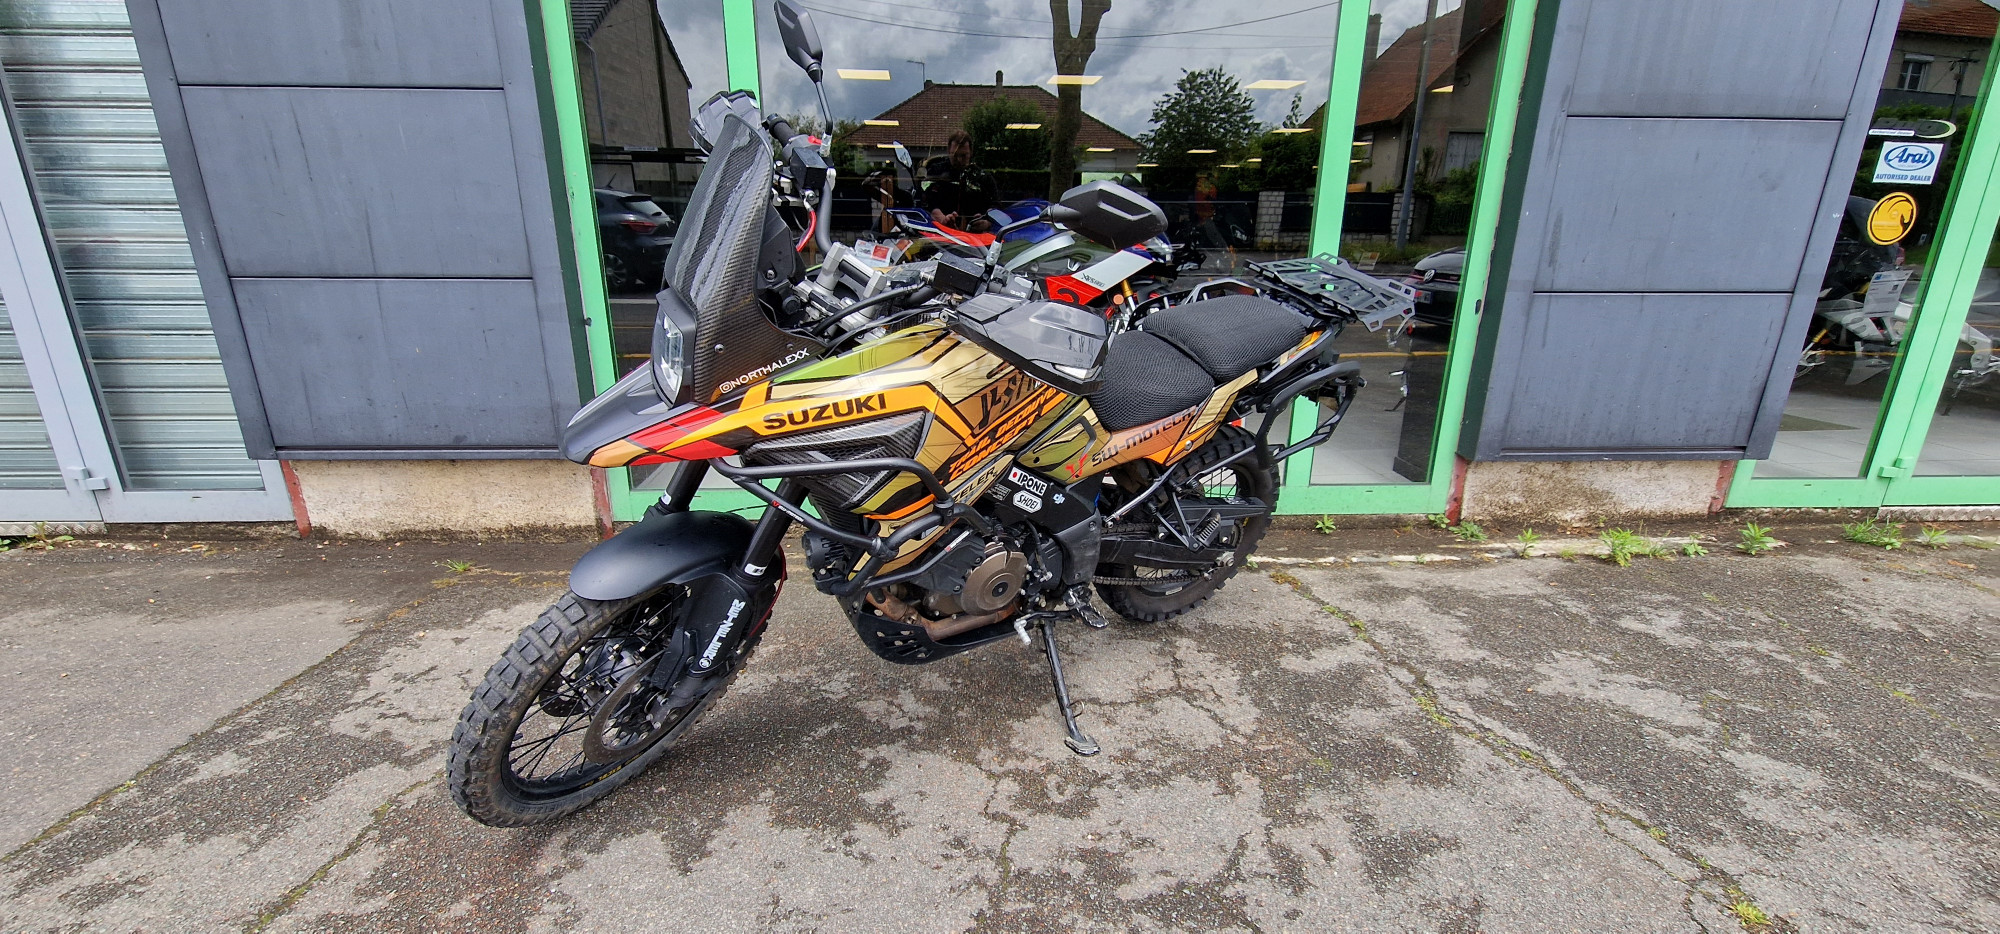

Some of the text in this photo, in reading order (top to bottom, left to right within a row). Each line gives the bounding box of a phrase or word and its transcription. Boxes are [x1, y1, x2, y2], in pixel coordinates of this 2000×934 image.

[1887, 147, 1930, 164] Arai
[1875, 173, 1909, 181] AUTORISED
[763, 392, 887, 431] SUZUKI
[949, 411, 1039, 482] CONCEPT
[1016, 472, 1047, 495] IPONE
[1018, 494, 1039, 510] SHOEI
[702, 598, 747, 661] METZELER
